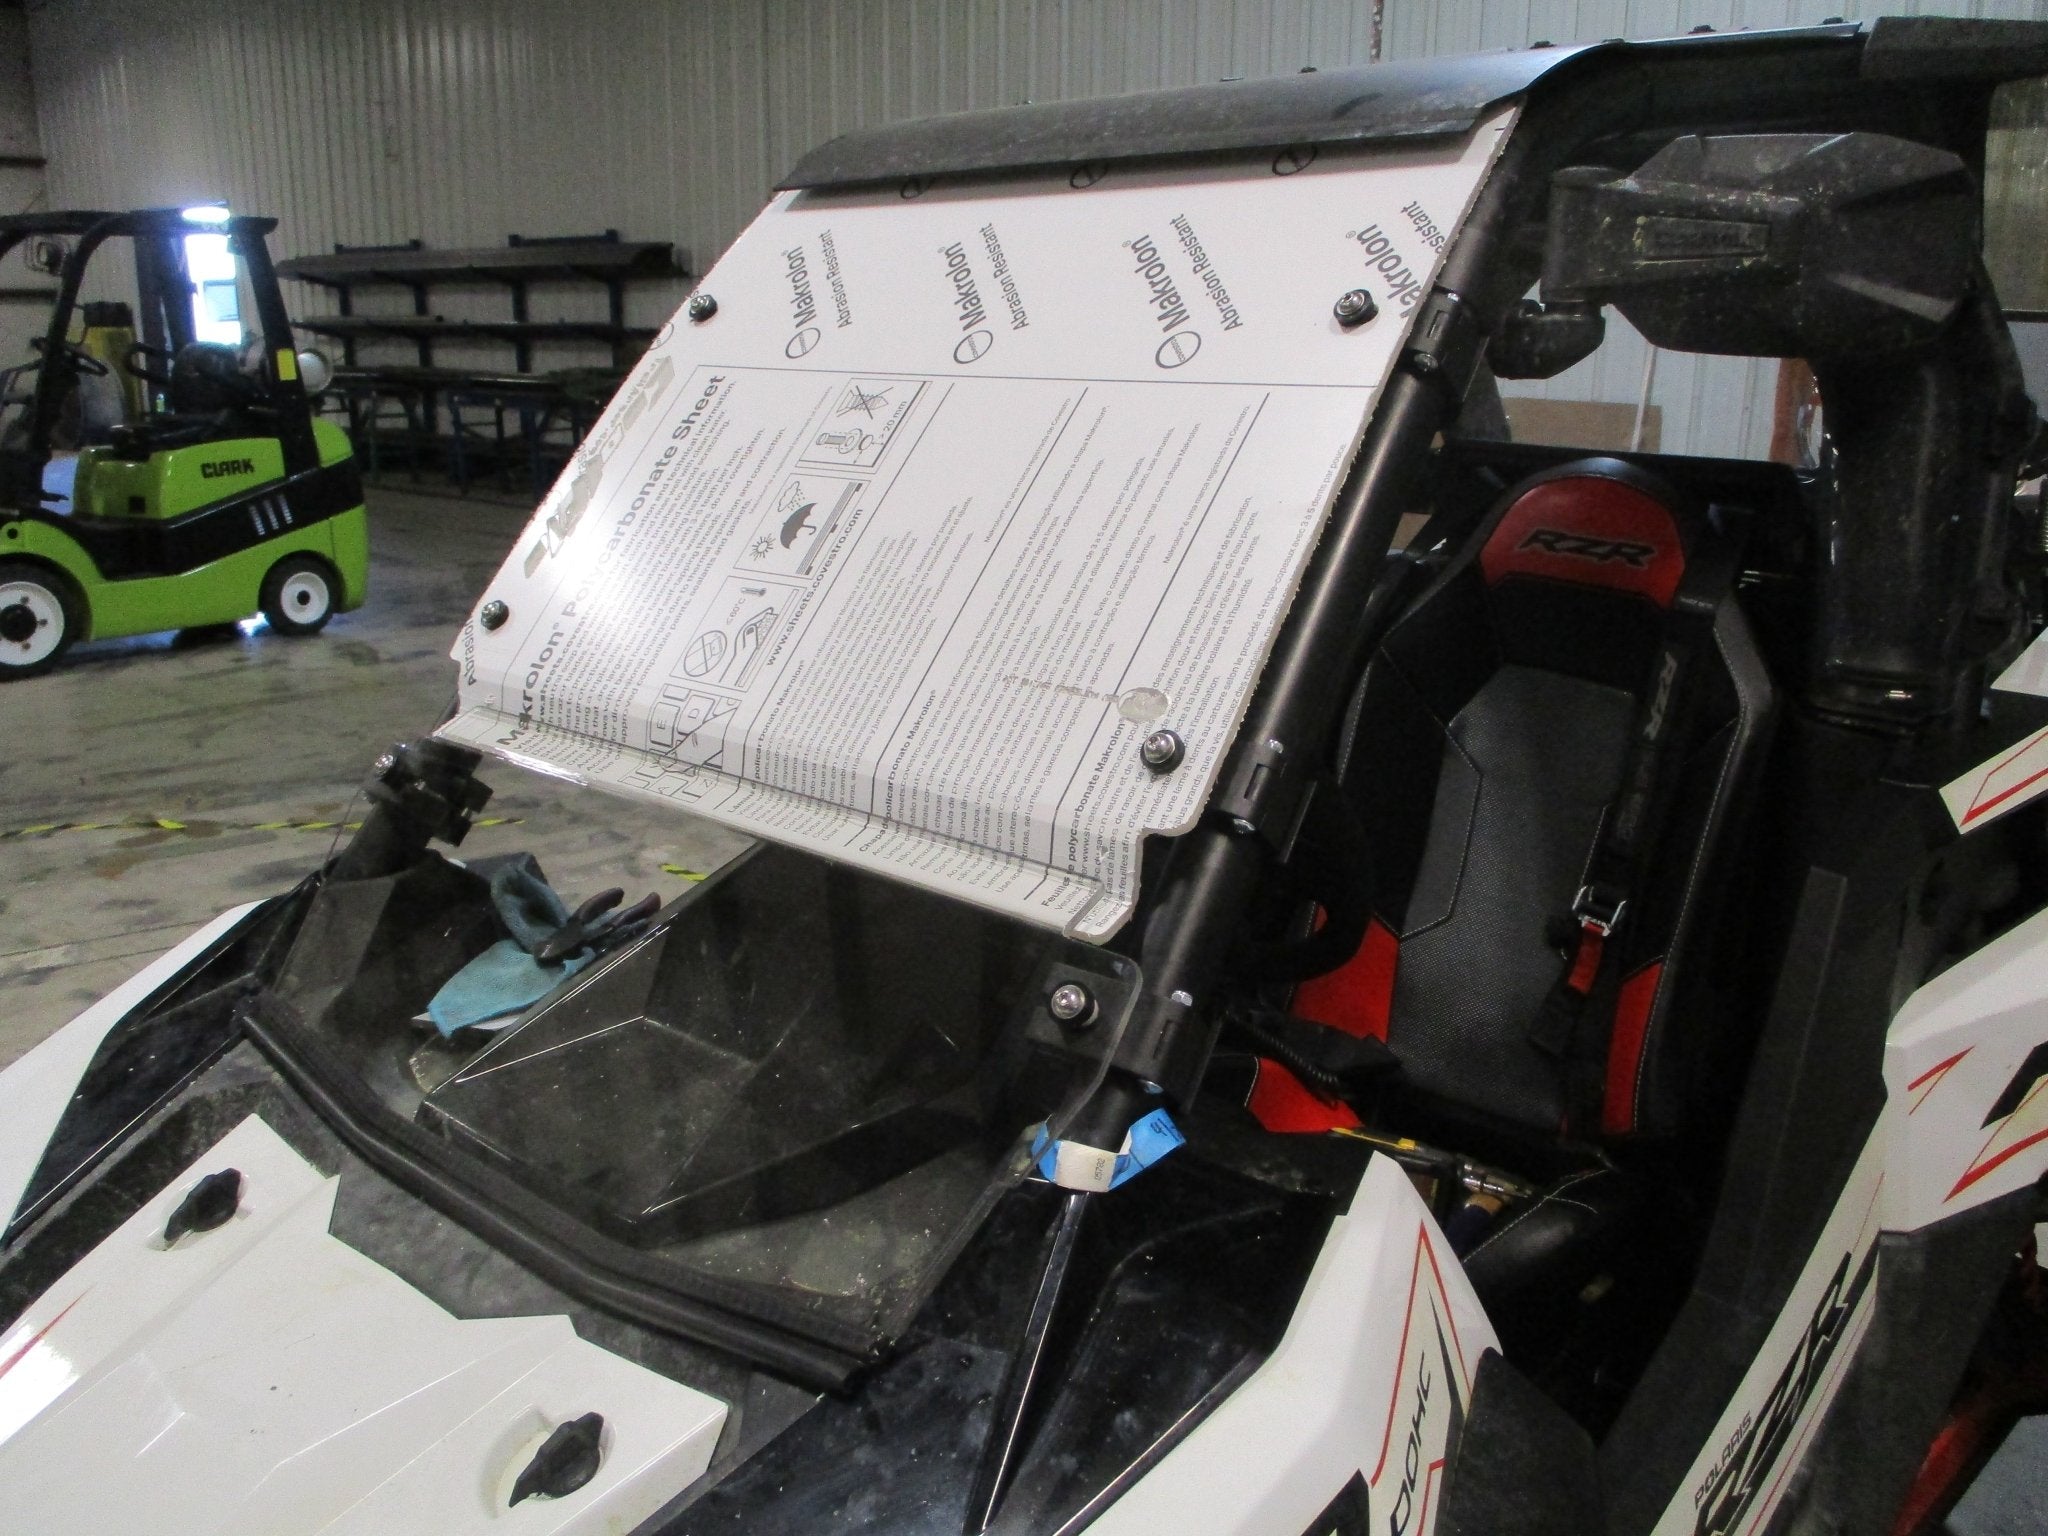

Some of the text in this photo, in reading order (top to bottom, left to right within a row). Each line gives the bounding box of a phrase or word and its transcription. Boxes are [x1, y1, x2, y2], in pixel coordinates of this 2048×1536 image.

[818, 229, 852, 328] Abrasion Resistant
[978, 222, 1029, 330] Abrasion Resistant
[1169, 213, 1243, 331] Abrasion Resistant
[672, 375, 726, 442] Sheet
[884, 418, 896, 433] 20
[892, 400, 908, 418] mm
[200, 458, 255, 479] CLARK
[766, 508, 864, 667] www.sheets.covestro.com
[1068, 769, 1100, 862] polycarbonate
[1694, 1411, 1752, 1510] POLARIS
